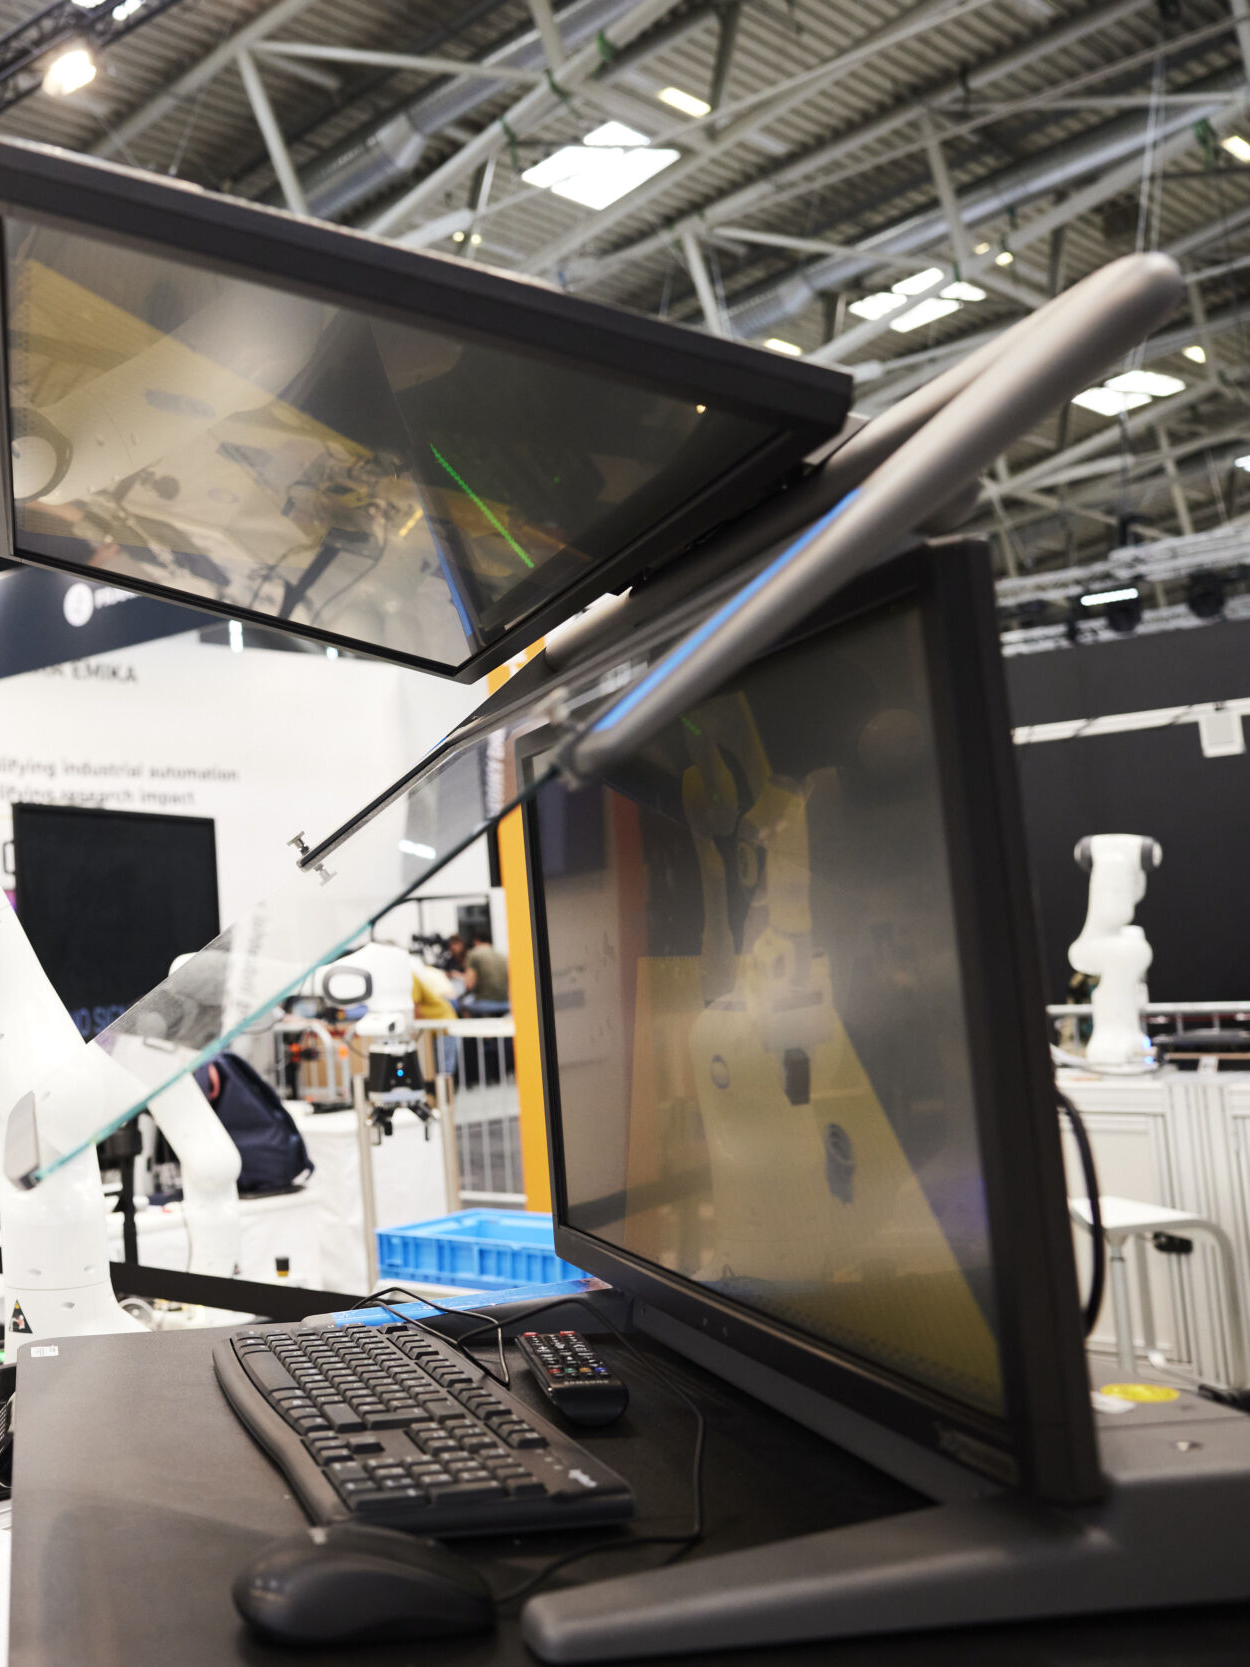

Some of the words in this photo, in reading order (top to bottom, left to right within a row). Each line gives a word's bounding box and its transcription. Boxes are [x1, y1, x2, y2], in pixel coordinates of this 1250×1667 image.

[64, 759, 143, 777] industrial
[150, 764, 239, 782] automation
[141, 791, 195, 806] impact
